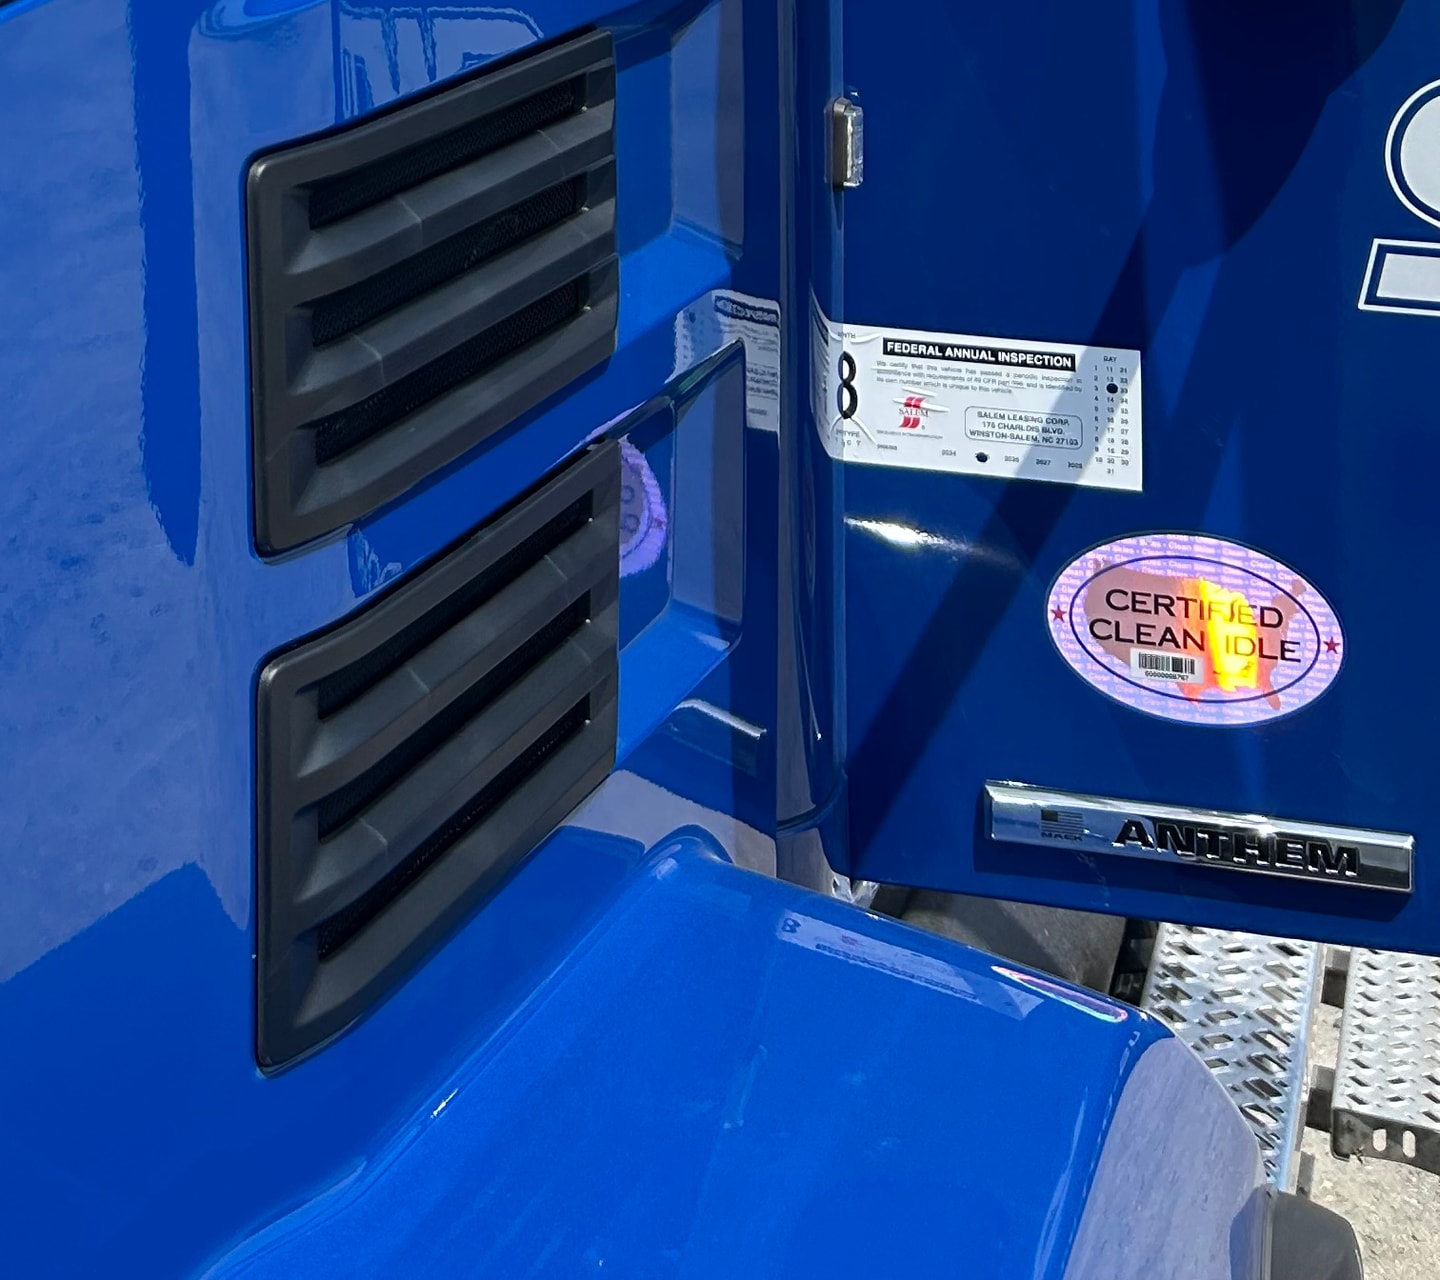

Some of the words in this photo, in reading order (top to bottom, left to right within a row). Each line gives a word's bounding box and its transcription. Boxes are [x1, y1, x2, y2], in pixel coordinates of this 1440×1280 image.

[886, 341, 942, 356] FEDERAL
[944, 346, 996, 361] ANNUAL
[997, 351, 1072, 368] INSPECTION
[837, 350, 858, 419] 8
[898, 407, 929, 418] SALEM
[977, 411, 1006, 421] SALEM
[1007, 413, 1044, 424] LEASING
[1042, 436, 1054, 444] NC
[1105, 588, 1284, 628] CERTIFIED
[1088, 618, 1205, 652] CLEAN
[1225, 635, 1302, 663] IDLE
[1041, 831, 1083, 841] MACK
[1111, 818, 1360, 877] ANTHEM
